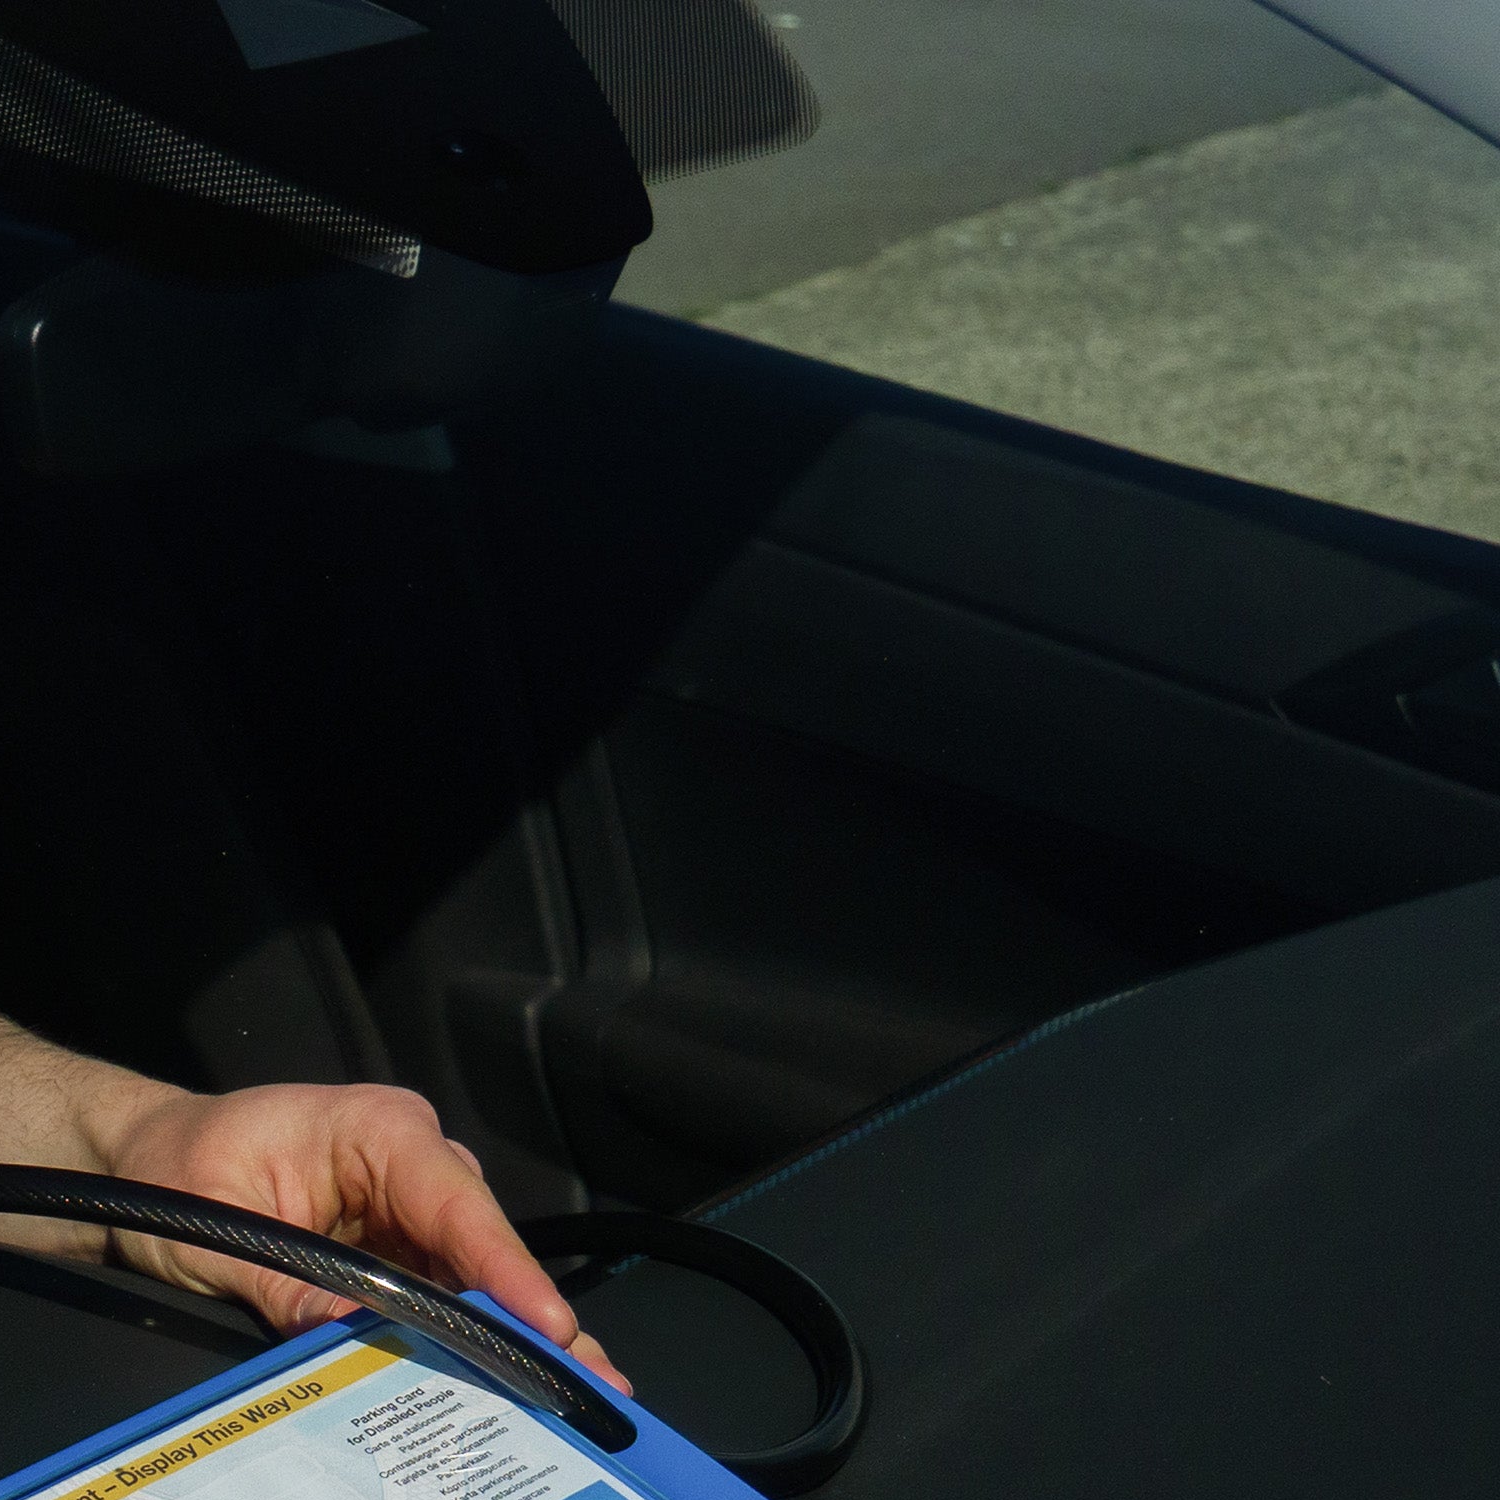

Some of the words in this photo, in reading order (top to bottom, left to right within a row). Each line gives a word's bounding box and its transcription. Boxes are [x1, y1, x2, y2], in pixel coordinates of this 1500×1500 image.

[347, 1433, 366, 1446] for
[364, 1408, 416, 1437] Disabled
[414, 1389, 455, 1411] People
[351, 1403, 398, 1427] Parking
[395, 1387, 425, 1405] Card
[115, 1443, 198, 1487] Display
[193, 1420, 244, 1447] This
[239, 1396, 292, 1424] Way
[287, 1380, 324, 1400] Up
[364, 1441, 391, 1454] Carte
[390, 1433, 404, 1443] de
[398, 1423, 455, 1453] Parkausweis
[440, 1439, 452, 1449] di
[426, 1461, 440, 1471] de
